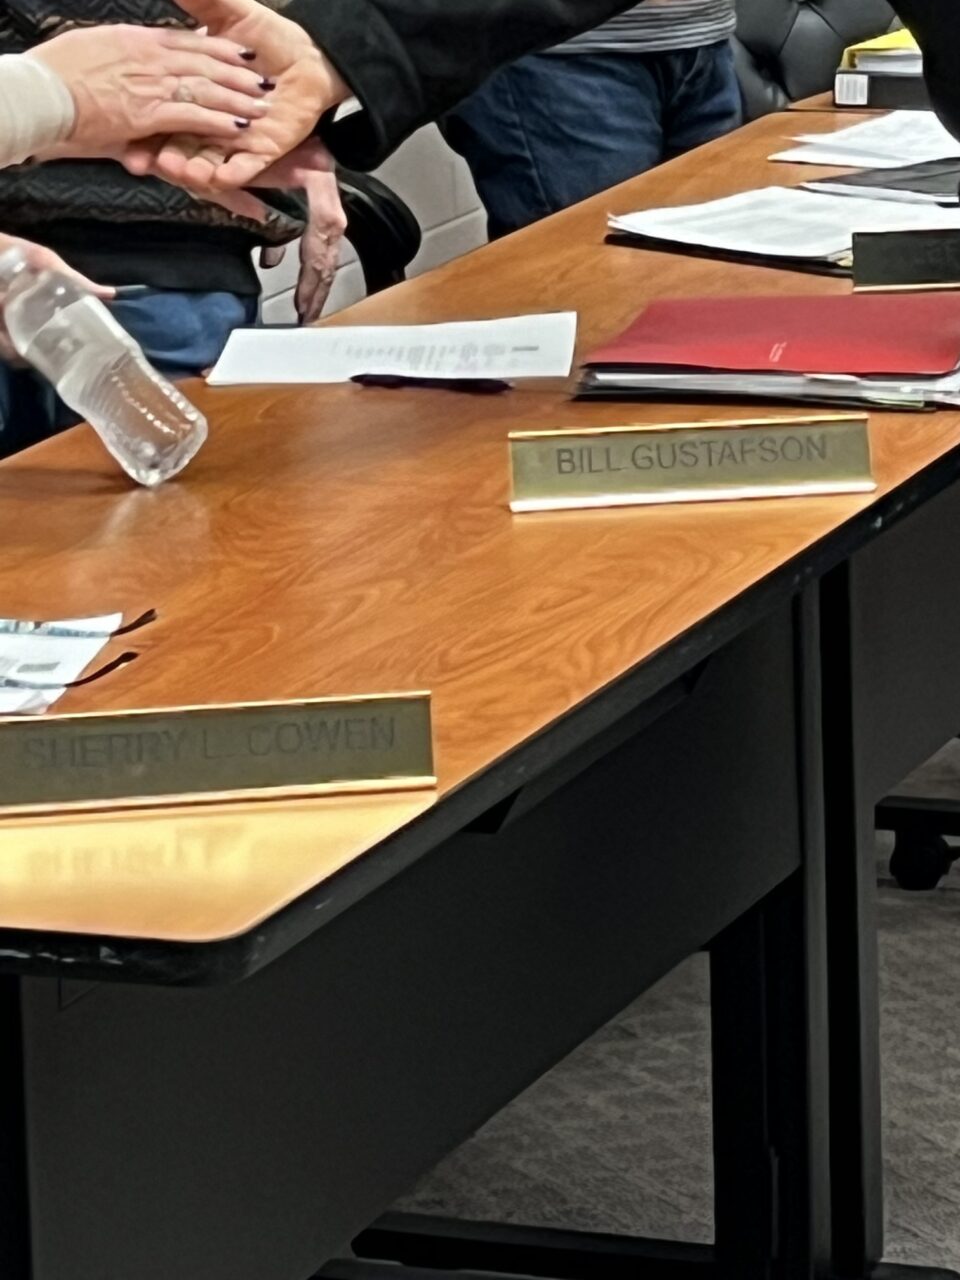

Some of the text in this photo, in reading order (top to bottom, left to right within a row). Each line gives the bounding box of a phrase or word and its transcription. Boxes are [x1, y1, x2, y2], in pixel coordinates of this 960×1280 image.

[555, 433, 828, 475] BILL GUSTAFSON
[23, 727, 189, 768] SHERRY
[247, 717, 395, 757] COWEN
